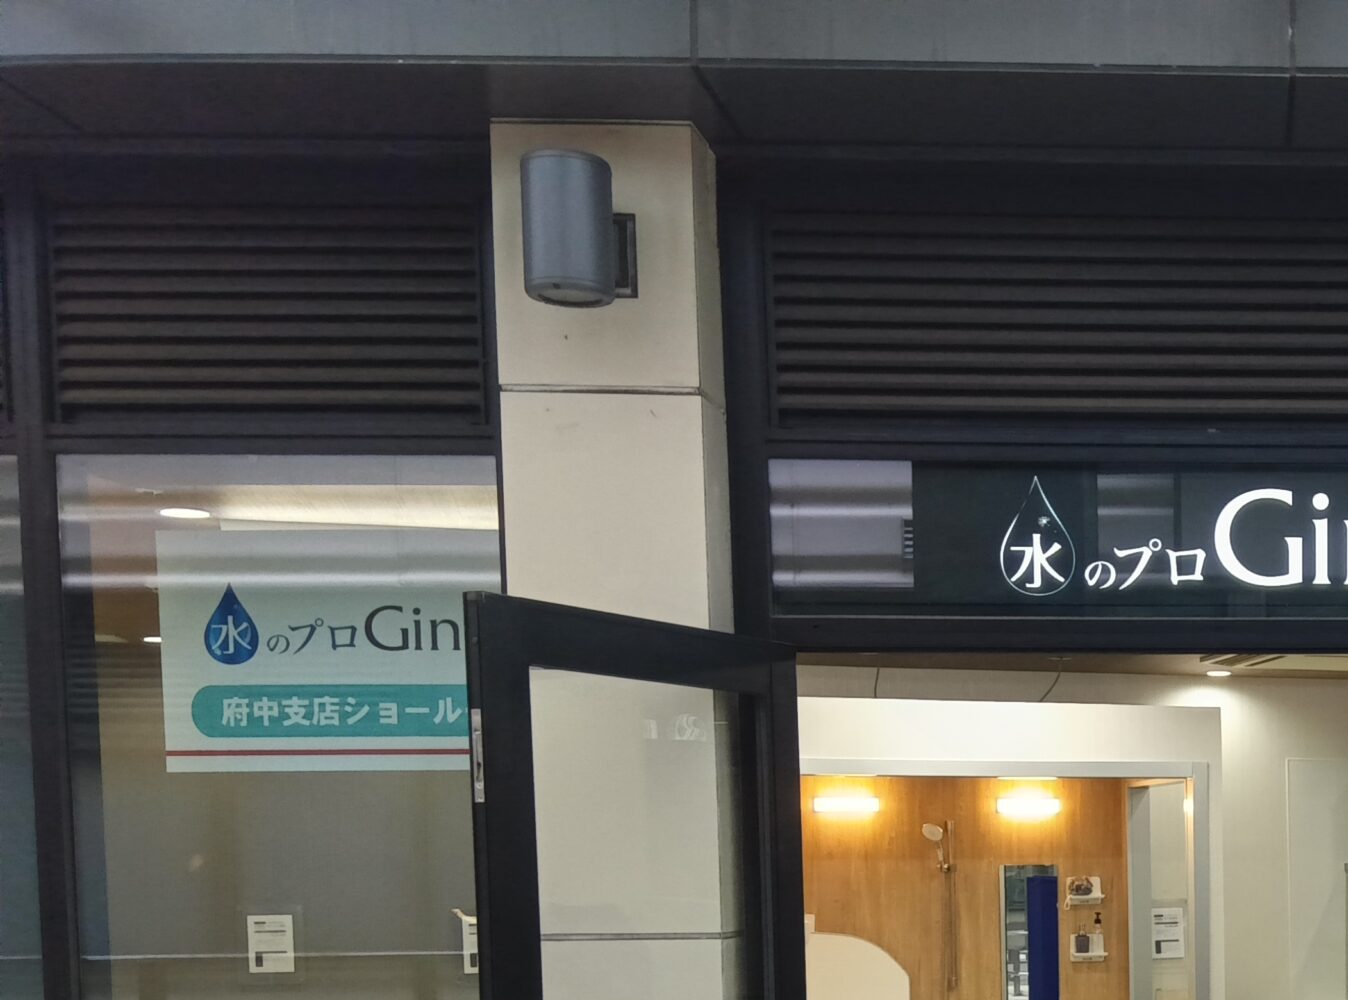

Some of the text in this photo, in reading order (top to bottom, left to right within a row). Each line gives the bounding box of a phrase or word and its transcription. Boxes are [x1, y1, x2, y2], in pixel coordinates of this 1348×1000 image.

[221, 696, 468, 728] 府中支店ショール
